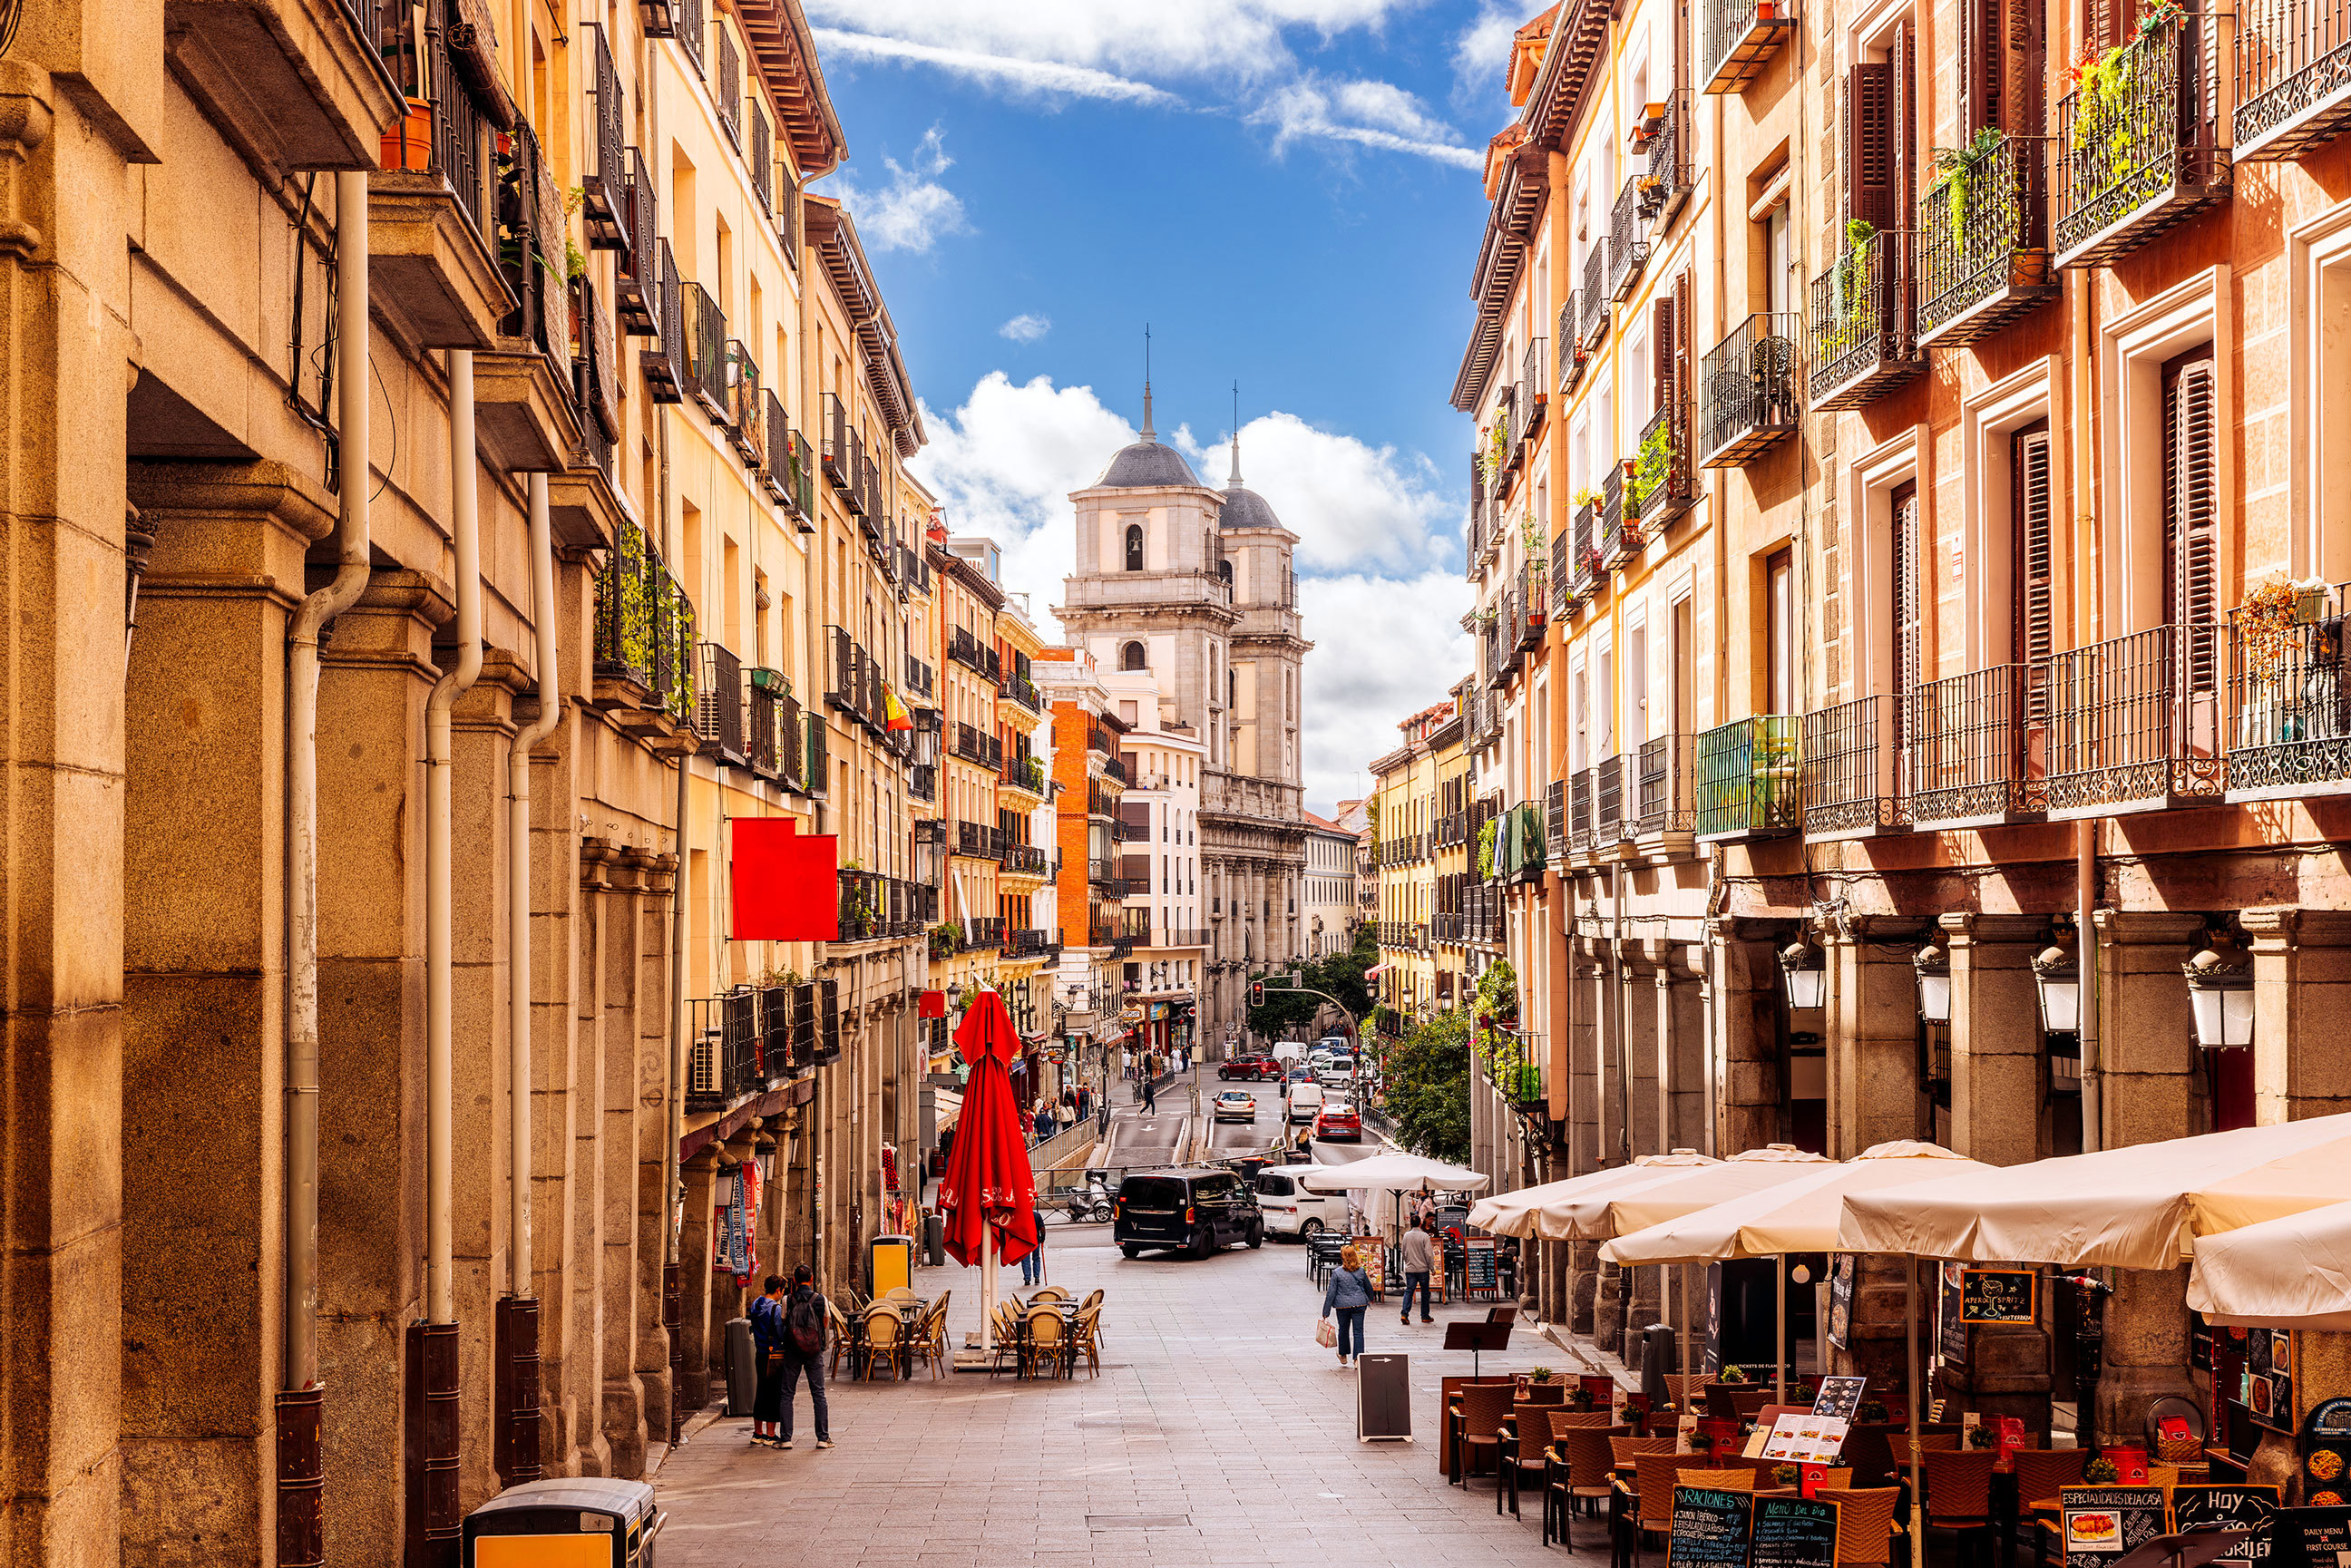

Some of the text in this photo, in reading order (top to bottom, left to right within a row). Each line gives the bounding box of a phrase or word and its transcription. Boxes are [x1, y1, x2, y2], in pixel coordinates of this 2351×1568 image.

[1997, 1296, 2024, 1305] SPRITZ
[1684, 1488, 1735, 1508] RACIONES
[2141, 1493, 2162, 1505] CASA
[2304, 1527, 2344, 1536] DAILY MENU
[2221, 1537, 2272, 1559] DRILEÑ
[2306, 1543, 2348, 1552] FIRST COURSE
